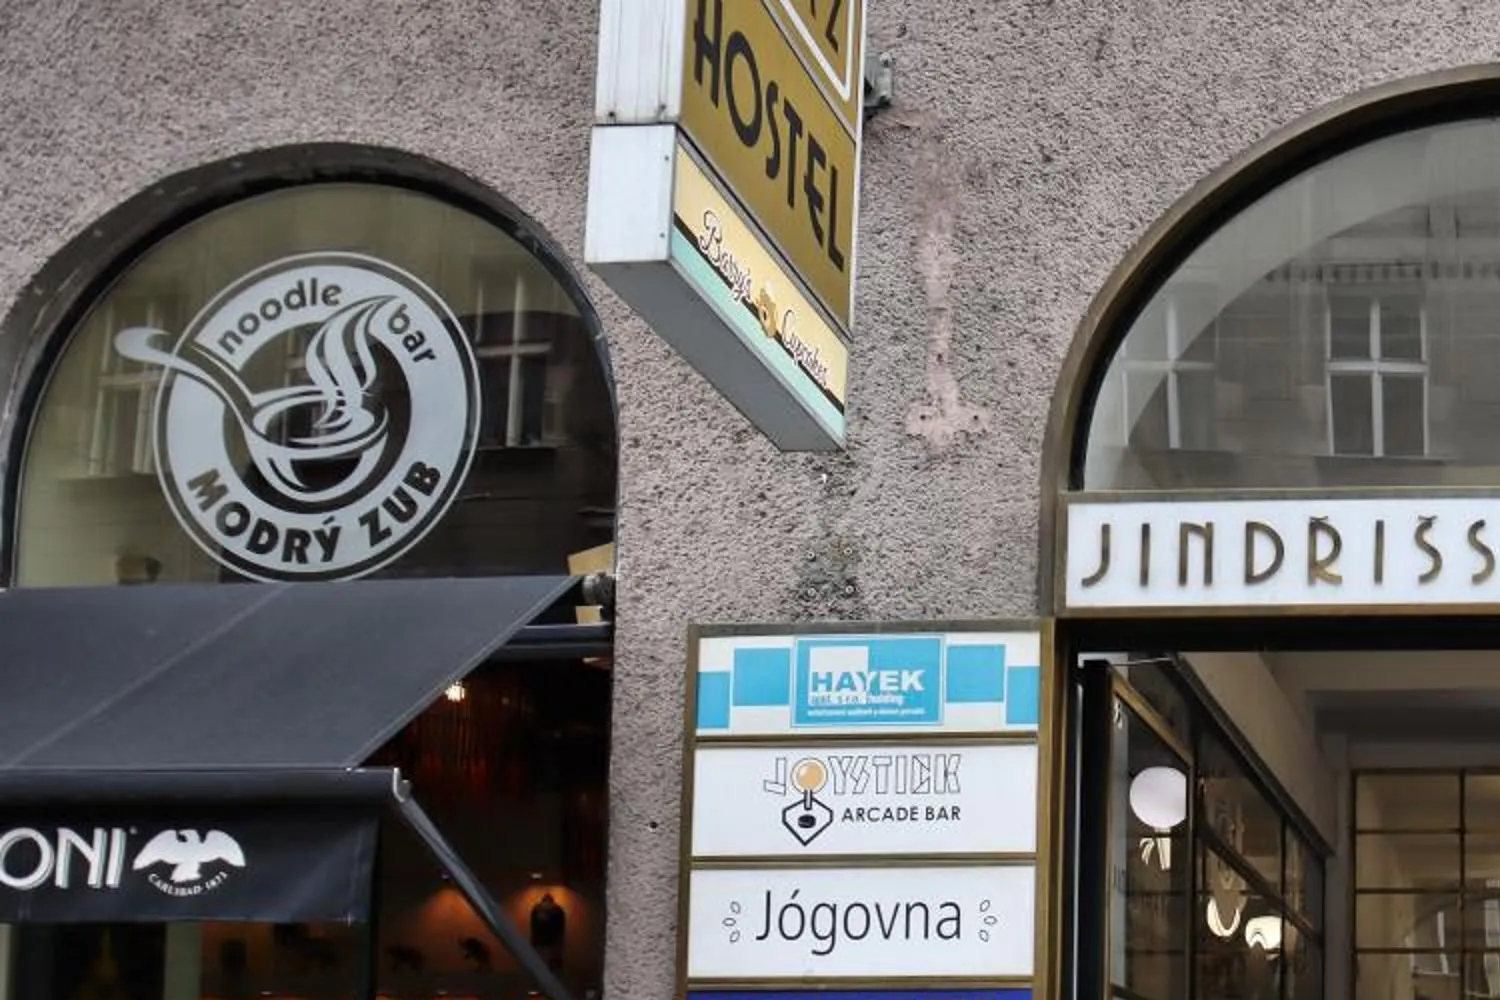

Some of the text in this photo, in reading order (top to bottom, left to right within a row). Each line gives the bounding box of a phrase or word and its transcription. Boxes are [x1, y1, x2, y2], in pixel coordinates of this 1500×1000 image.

[694, 0, 845, 272] HOSTEL
[217, 277, 437, 364] noodle bar
[186, 461, 441, 564] MODRÝ ZUB
[811, 669, 926, 692] HAYEK
[841, 806, 961, 823] ARCADE BAR
[755, 888, 962, 956] Jógovna
